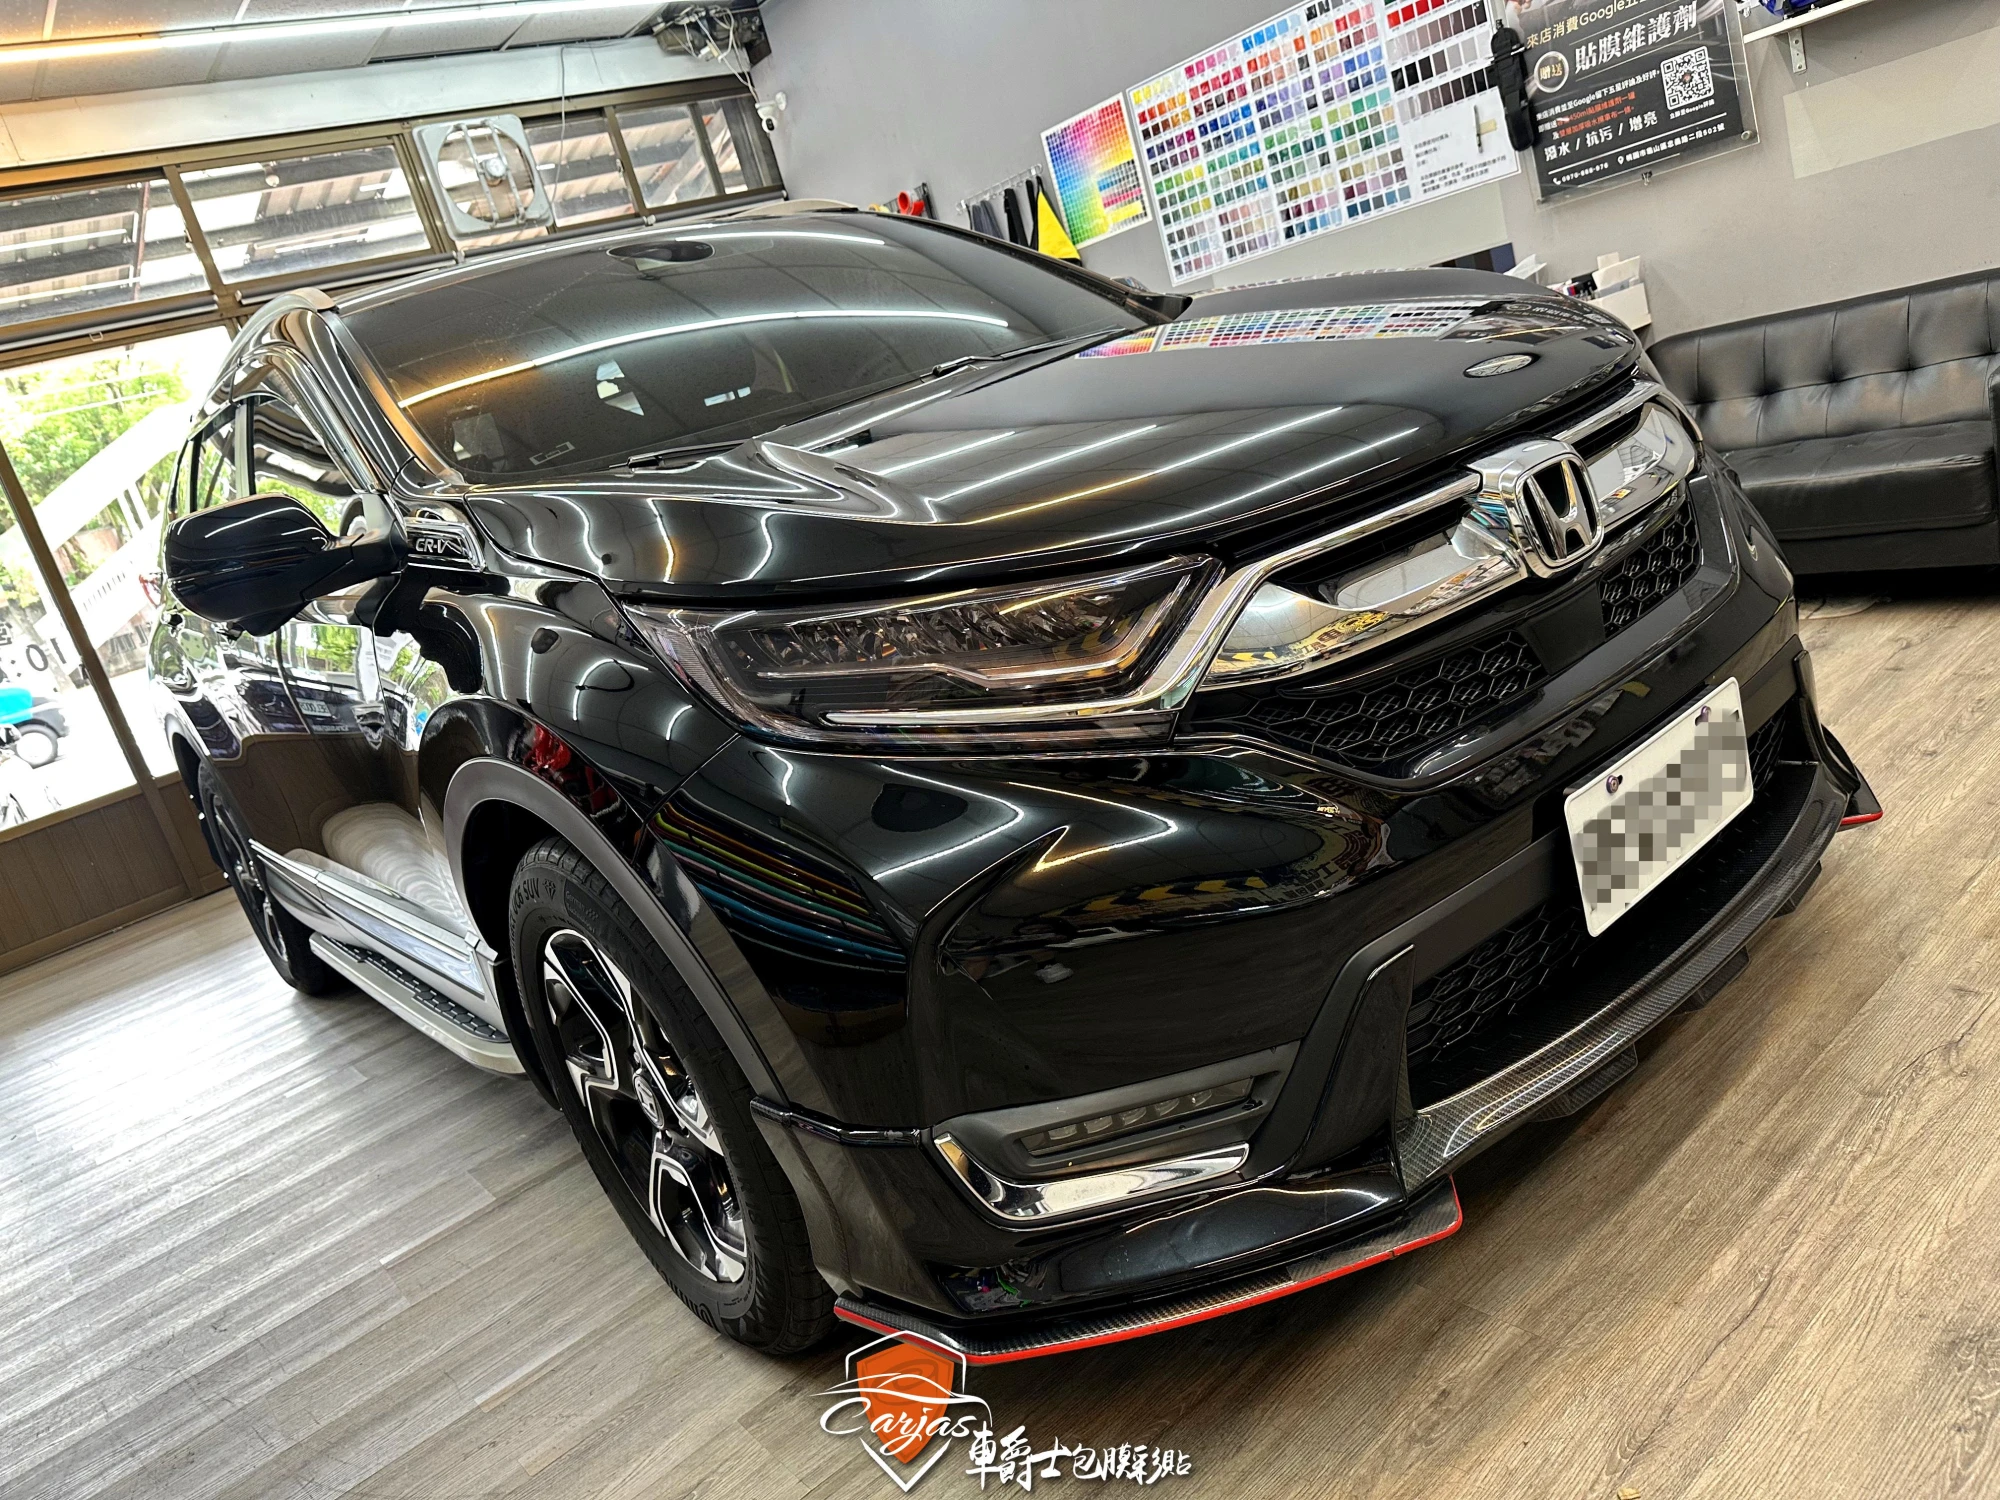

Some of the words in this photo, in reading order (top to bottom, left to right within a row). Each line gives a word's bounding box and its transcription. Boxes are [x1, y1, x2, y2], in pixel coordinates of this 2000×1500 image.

[1526, 0, 1646, 48] 來店消費Google五
[1575, 1, 1697, 74] 貼膜維護劑
[1585, 127, 1613, 148] 抗污
[1629, 111, 1658, 132] 增亮
[415, 538, 448, 553] CR-V
[522, 877, 539, 900] SUV
